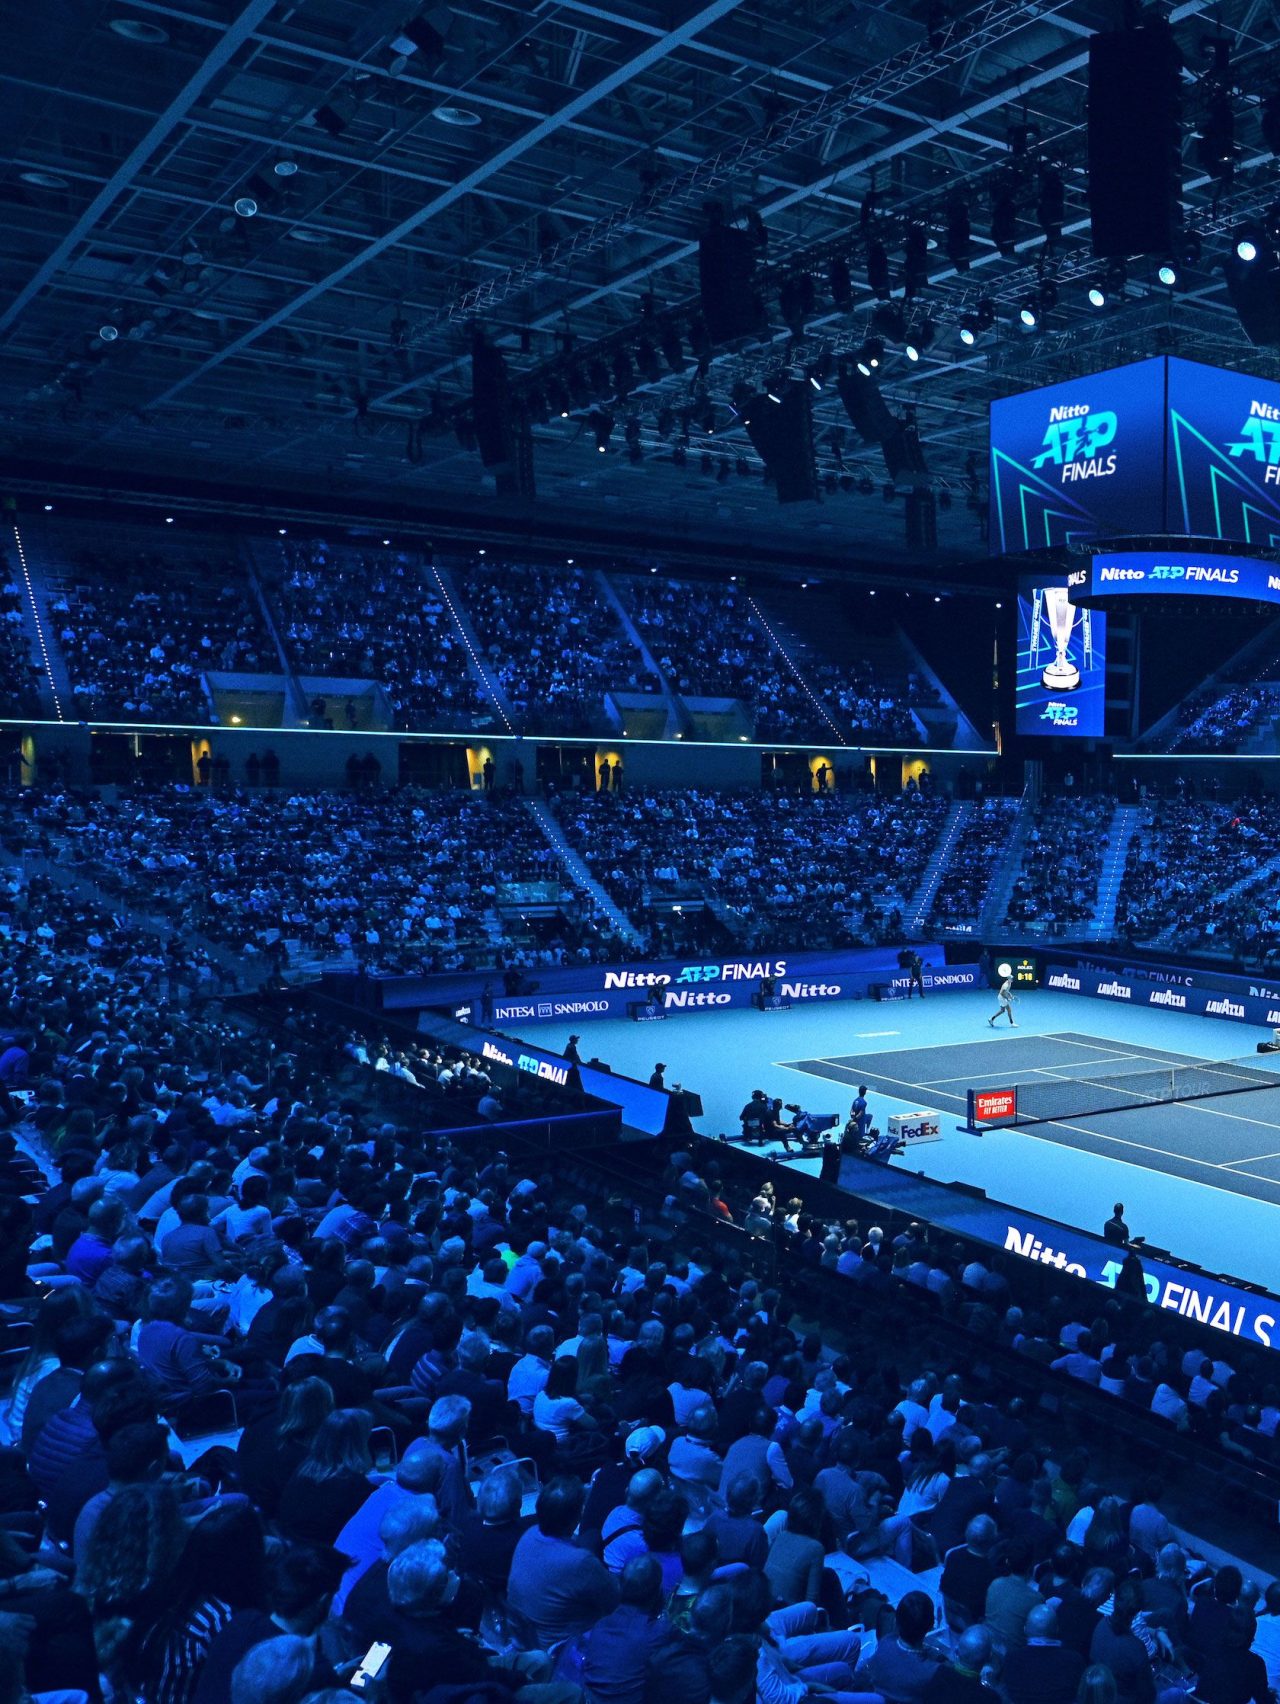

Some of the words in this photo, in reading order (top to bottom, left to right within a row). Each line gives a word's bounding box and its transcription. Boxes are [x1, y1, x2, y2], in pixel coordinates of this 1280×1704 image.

[1050, 404, 1090, 422] Nitto
[1030, 410, 1118, 469] ATP
[1062, 454, 1117, 483] FINALS
[1100, 568, 1144, 581] Nitto
[1148, 565, 1185, 579] ATP
[1185, 566, 1239, 583] FINALS
[1040, 706, 1078, 720] ATP
[604, 971, 671, 989] Nitto
[675, 965, 720, 983] ATP
[722, 961, 786, 981] FINALS
[934, 973, 974, 986] SANPAOLO
[1048, 973, 1081, 990] LAVAZZA
[781, 983, 841, 998] Nitto
[1097, 981, 1131, 998] LAVAZZA
[1150, 989, 1186, 1007] LAVAZZA
[664, 991, 731, 1008] Nitto
[1205, 998, 1245, 1018] LAVAZZA
[495, 1006, 535, 1019] INTESA
[554, 1001, 609, 1015] SANPAOLO
[978, 1096, 1013, 1108] Emirates
[901, 1121, 939, 1139] FedEx
[1003, 1226, 1087, 1279] Nitto
